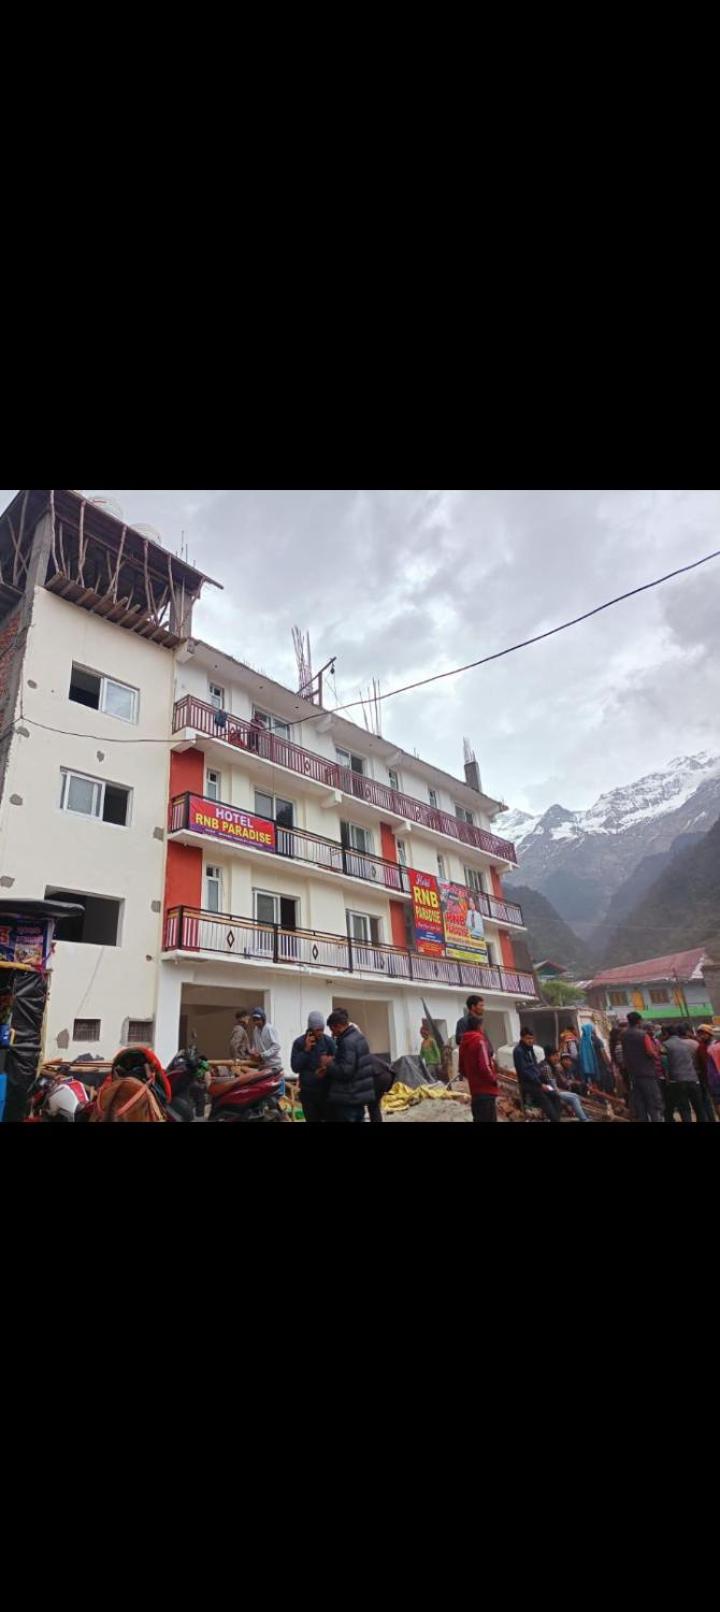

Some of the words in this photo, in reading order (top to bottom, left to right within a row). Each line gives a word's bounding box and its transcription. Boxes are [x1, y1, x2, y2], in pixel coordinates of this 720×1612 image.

[215, 808, 253, 828] HOTEL
[195, 813, 219, 830] RNB
[222, 821, 272, 845] PARADISE
[413, 887, 438, 907] RNB
